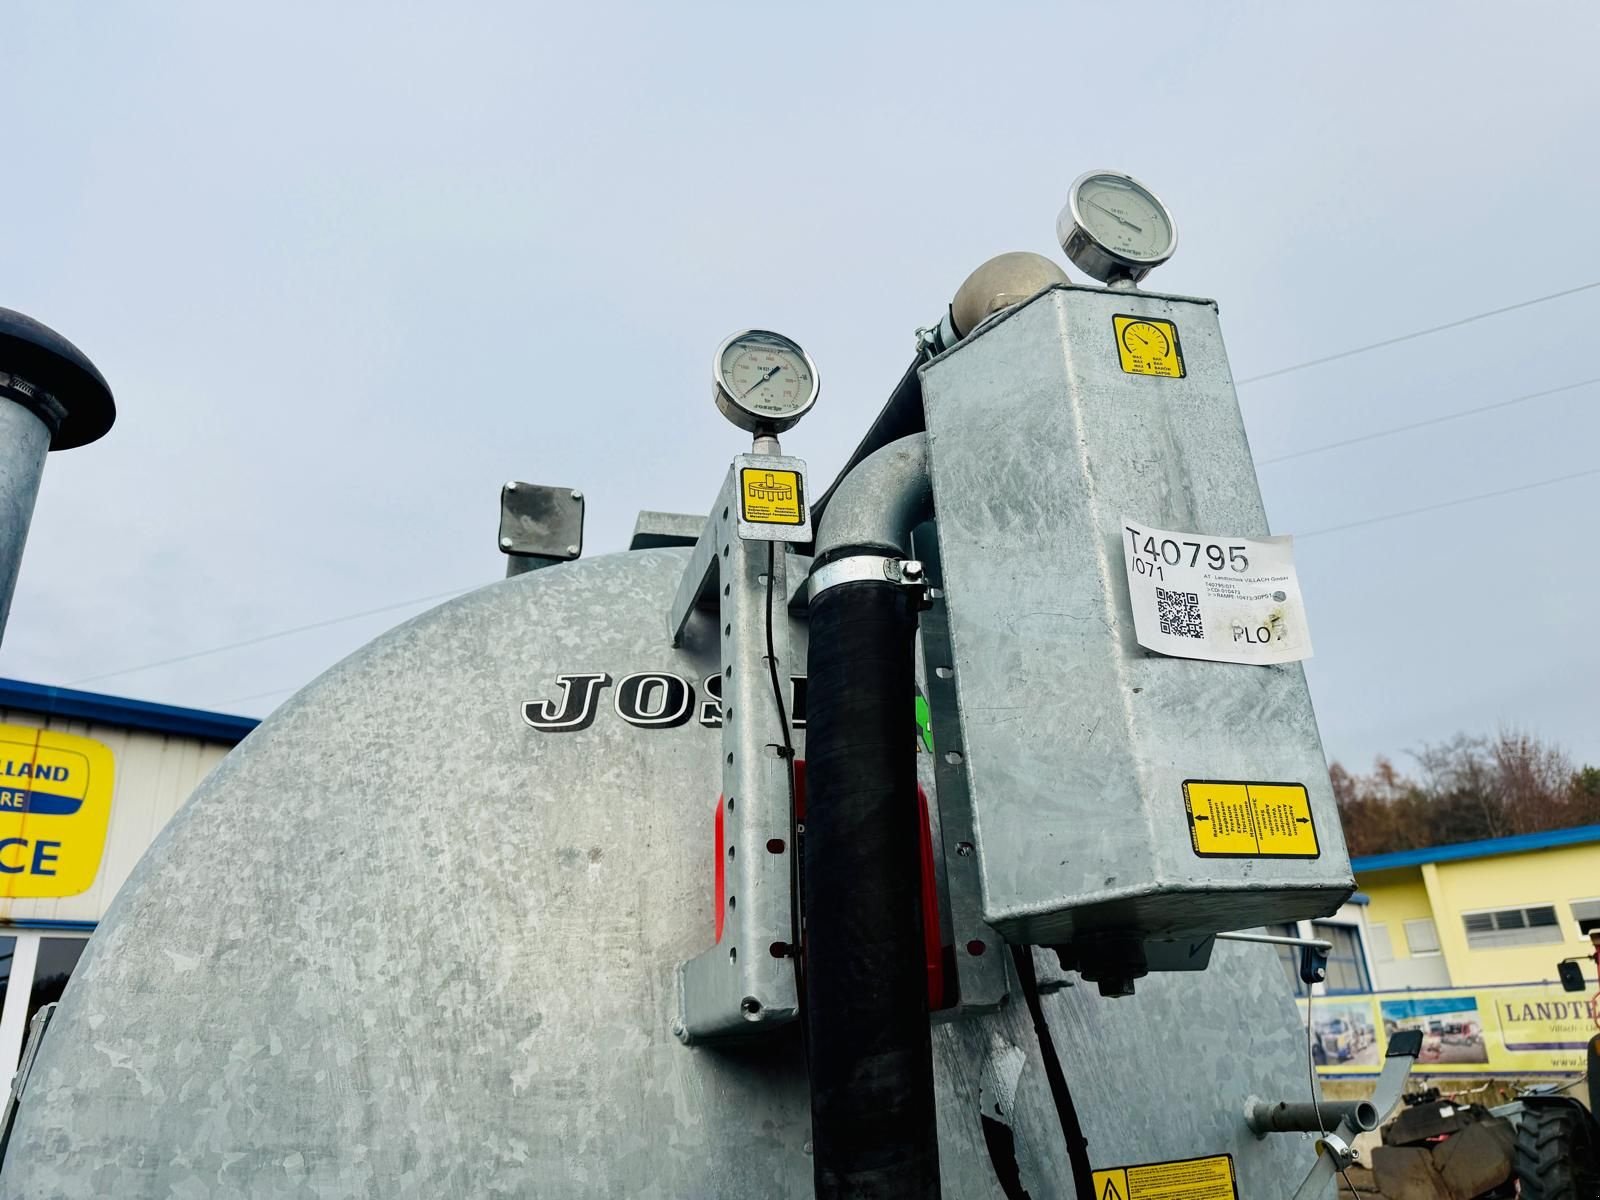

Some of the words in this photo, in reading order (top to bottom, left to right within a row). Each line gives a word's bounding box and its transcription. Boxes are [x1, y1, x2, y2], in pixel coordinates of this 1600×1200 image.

[1126, 526, 1249, 573] T40795
[1132, 556, 1164, 582] /071
[0, 837, 61, 876] CE
